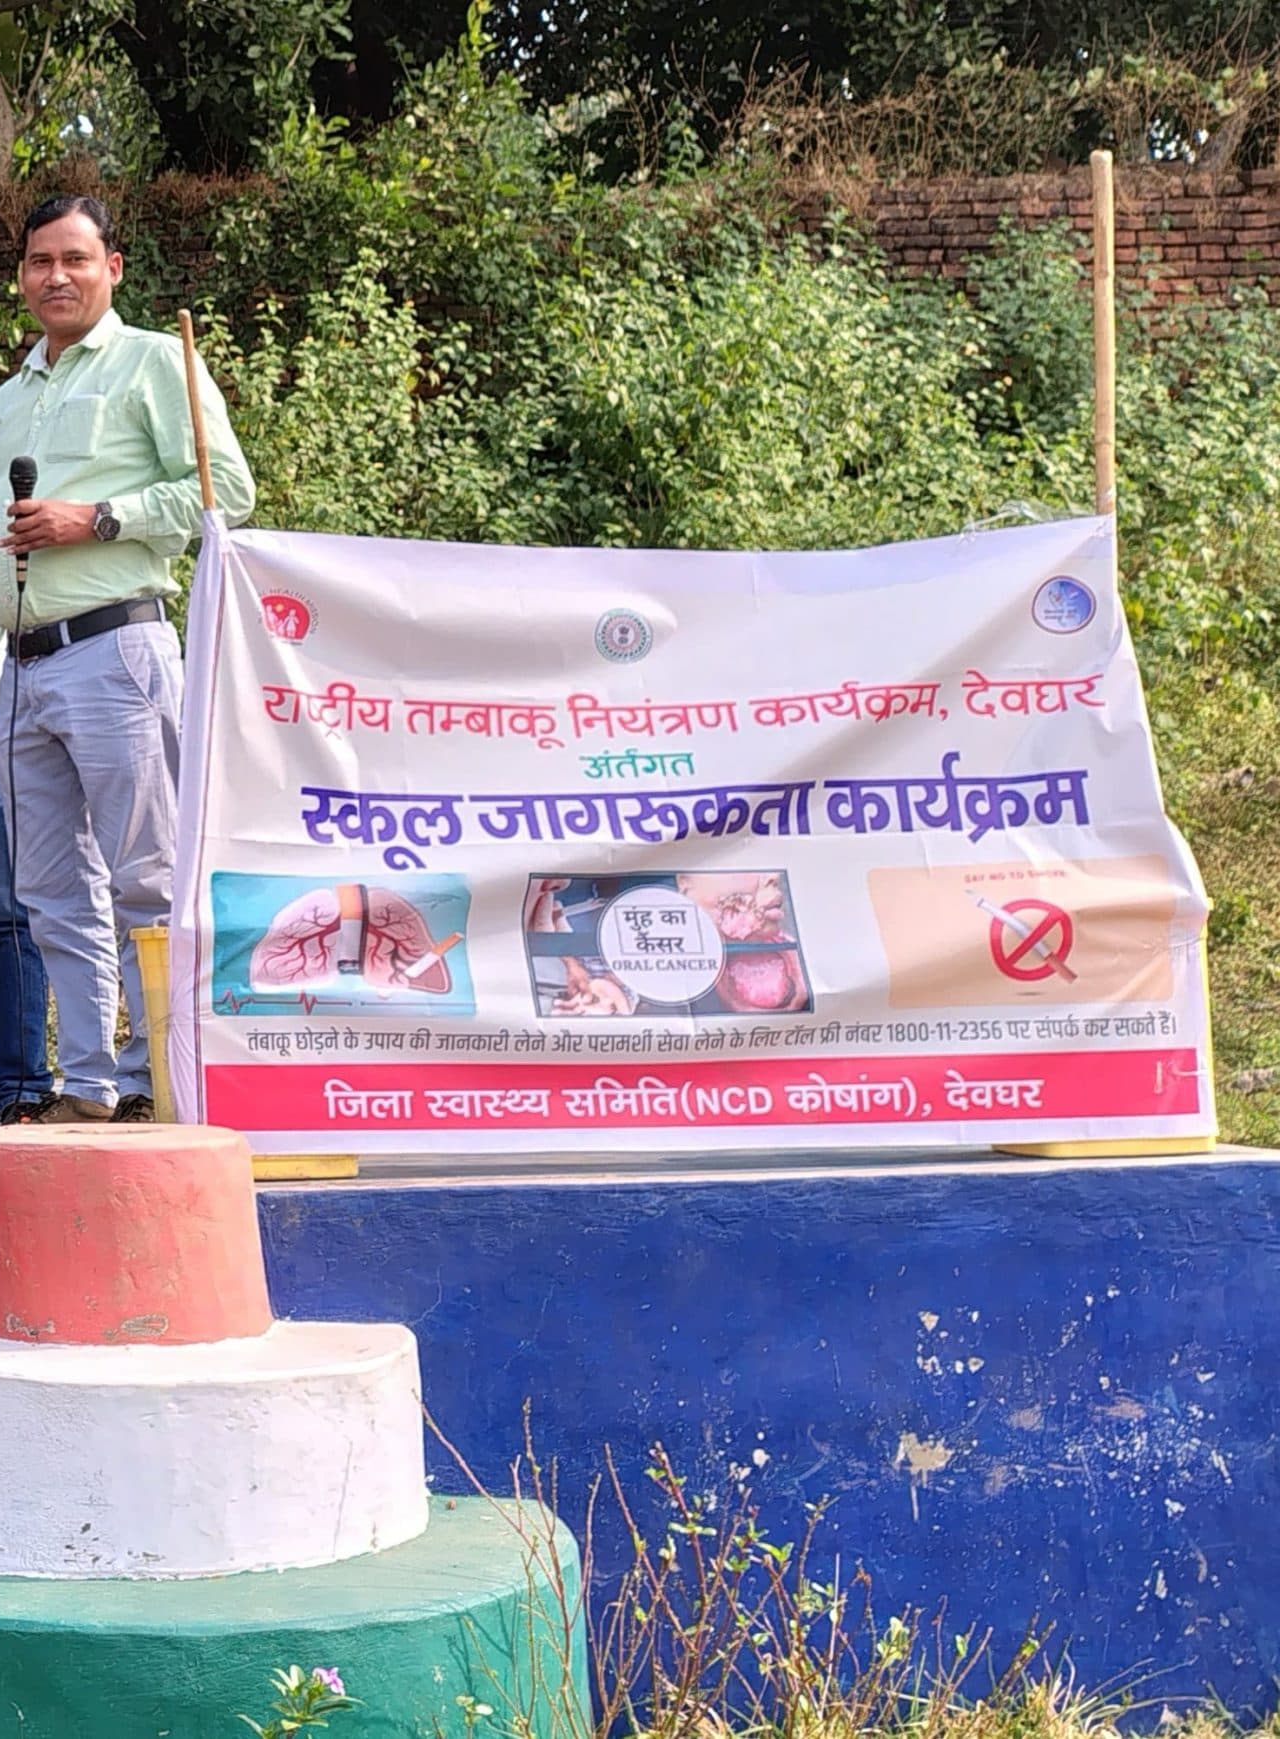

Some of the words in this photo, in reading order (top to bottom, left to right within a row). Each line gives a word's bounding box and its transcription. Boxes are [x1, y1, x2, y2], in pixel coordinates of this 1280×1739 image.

[262, 683, 392, 739] राष्ट्रीय
[404, 699, 564, 749] तम्बाकू
[567, 693, 737, 738] नियंत्रण
[749, 681, 948, 728] कार्यक्रम,
[962, 670, 1105, 718] देवघर
[301, 787, 463, 870] स्कूल
[468, 781, 816, 841] जागरूकता
[824, 752, 1089, 843] कार्यक्रम
[623, 906, 653, 931] मुंह
[659, 910, 686, 925] का
[612, 959, 653, 971] ORAL
[655, 959, 718, 971] CANCER
[246, 1028, 292, 1057] तंबाकू
[294, 1026, 340, 1055] छोड़ने
[343, 1027, 360, 1050] के
[363, 1031, 405, 1050] उपाय
[409, 1027, 432, 1051] की
[435, 1029, 509, 1052] जानकारी
[514, 1029, 546, 1052] लेने
[551, 1029, 584, 1053] और
[656, 1028, 691, 1052] सेवा
[694, 1028, 725, 1052] लेने
[729, 1028, 745, 1048] के
[748, 1026, 782, 1048] लिए
[784, 1024, 816, 1046] टॉल
[819, 1021, 842, 1044] फ्री
[845, 1021, 882, 1043] नंबर
[887, 1019, 1003, 1042] 1800-11-2356
[1005, 1019, 1035, 1041] पर
[1034, 1014, 1081, 1039] संपर्क
[1083, 1017, 1113, 1037] कर
[1113, 1012, 1156, 1037] सकते
[323, 1078, 413, 1119] जिला
[424, 1089, 551, 1118] स्वास्थ्य
[784, 1073, 932, 1117] कोषांग),
[944, 1070, 1045, 1110] देवघर
